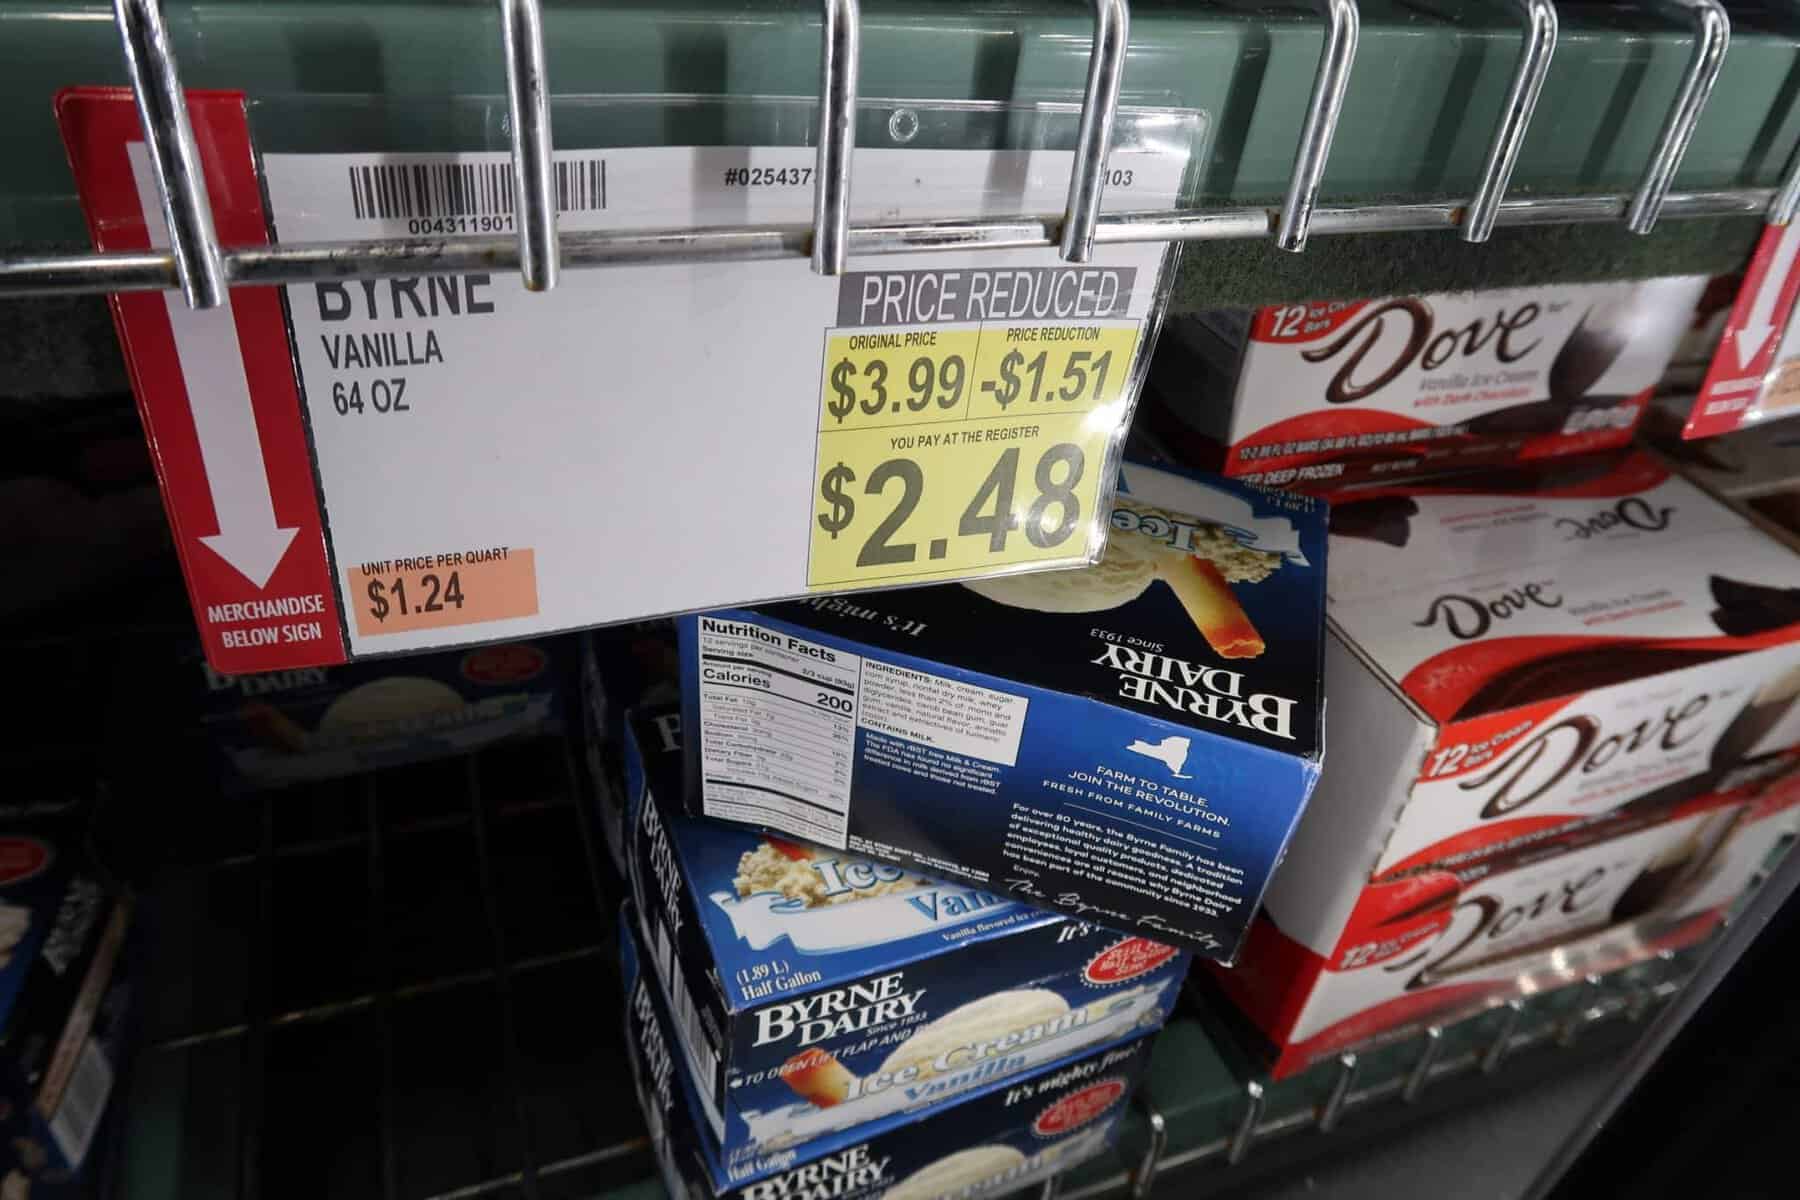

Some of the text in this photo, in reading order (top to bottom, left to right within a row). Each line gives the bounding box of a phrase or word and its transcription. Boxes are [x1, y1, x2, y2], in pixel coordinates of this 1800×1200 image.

[315, 274, 495, 321] BYRNE
[860, 270, 1120, 324] PRICE REDUCED
[1272, 305, 1300, 336] 12
[320, 330, 444, 369] VANILLA
[849, 331, 937, 350] ORIGINAL PRICE
[1006, 326, 1101, 342] PRICE REDUCTION
[1301, 298, 1543, 404] Dove
[333, 378, 410, 416] 64 OZ
[827, 355, 966, 424] $3.99
[980, 347, 1113, 411] -$1.51
[890, 425, 1040, 450] YOU PAY AT THE REGISTER
[817, 442, 1087, 568] $2.48
[361, 547, 509, 576] UNIT PRICE PER QUART
[207, 594, 325, 624] MERCHANDISE
[367, 571, 464, 623] $1.24
[1412, 583, 1562, 639] Dove
[222, 622, 322, 648] BELOW SIGN
[703, 619, 836, 662] Nutrition Facts
[703, 669, 852, 713] Calories 200
[866, 662, 930, 683] INGREDIENTS:
[1092, 643, 1245, 687] DAIRY
[862, 718, 908, 735] CONTAINS
[1119, 674, 1298, 742] BYRNE
[1431, 744, 1470, 777] 12
[1458, 694, 1710, 820] Dove
[1043, 780, 1221, 839] FRESH FROM FAMILY FARMS
[1068, 771, 1230, 826] JOIN THE REVOLUTION.
[1097, 766, 1209, 808] FARM TO TABLE.
[1008, 820, 1020, 830] of
[1021, 823, 1081, 848] exceptional
[1081, 840, 1119, 858] quality
[1169, 866, 1225, 889] dedicated
[1011, 810, 1060, 832] delivering
[1061, 824, 1101, 843] healthy
[1102, 836, 1129, 851] dairy
[1196, 865, 1243, 885] tradition
[1031, 807, 1053, 820] over
[1105, 827, 1124, 839] the
[1125, 833, 1157, 849] Byrne
[1159, 843, 1195, 861] Family
[1195, 855, 1215, 867] has
[1216, 862, 1244, 876] been
[1022, 854, 1047, 867] been
[1048, 861, 1070, 874] part
[1072, 868, 1083, 876] of
[1085, 871, 1103, 882] the
[1104, 877, 1162, 900] community
[1163, 895, 1190, 908] since
[1073, 859, 1090, 869] are
[1106, 868, 1146, 885] reasons
[1147, 880, 1170, 893] why
[1170, 887, 1202, 903] Byrne
[1203, 897, 1233, 913] Dairy
[1147, 870, 1168, 882] and
[1053, 893, 1131, 921] Byrne
[1136, 915, 1222, 950] Family
[741, 969, 822, 1001] Half Gallon
[752, 972, 904, 1047] BYRNE
[798, 989, 927, 1047] DAIRY
[745, 1071, 766, 1087] TO
[767, 1057, 810, 1079] OPEN
[842, 1038, 880, 1059] FLAP
[878, 1027, 913, 1046] AND
[846, 1006, 1090, 1100] Ice Cream
[904, 1054, 1026, 1100] Vanilla
[743, 1144, 870, 1200] BYRNE
[786, 1155, 891, 1200] DAIRY
